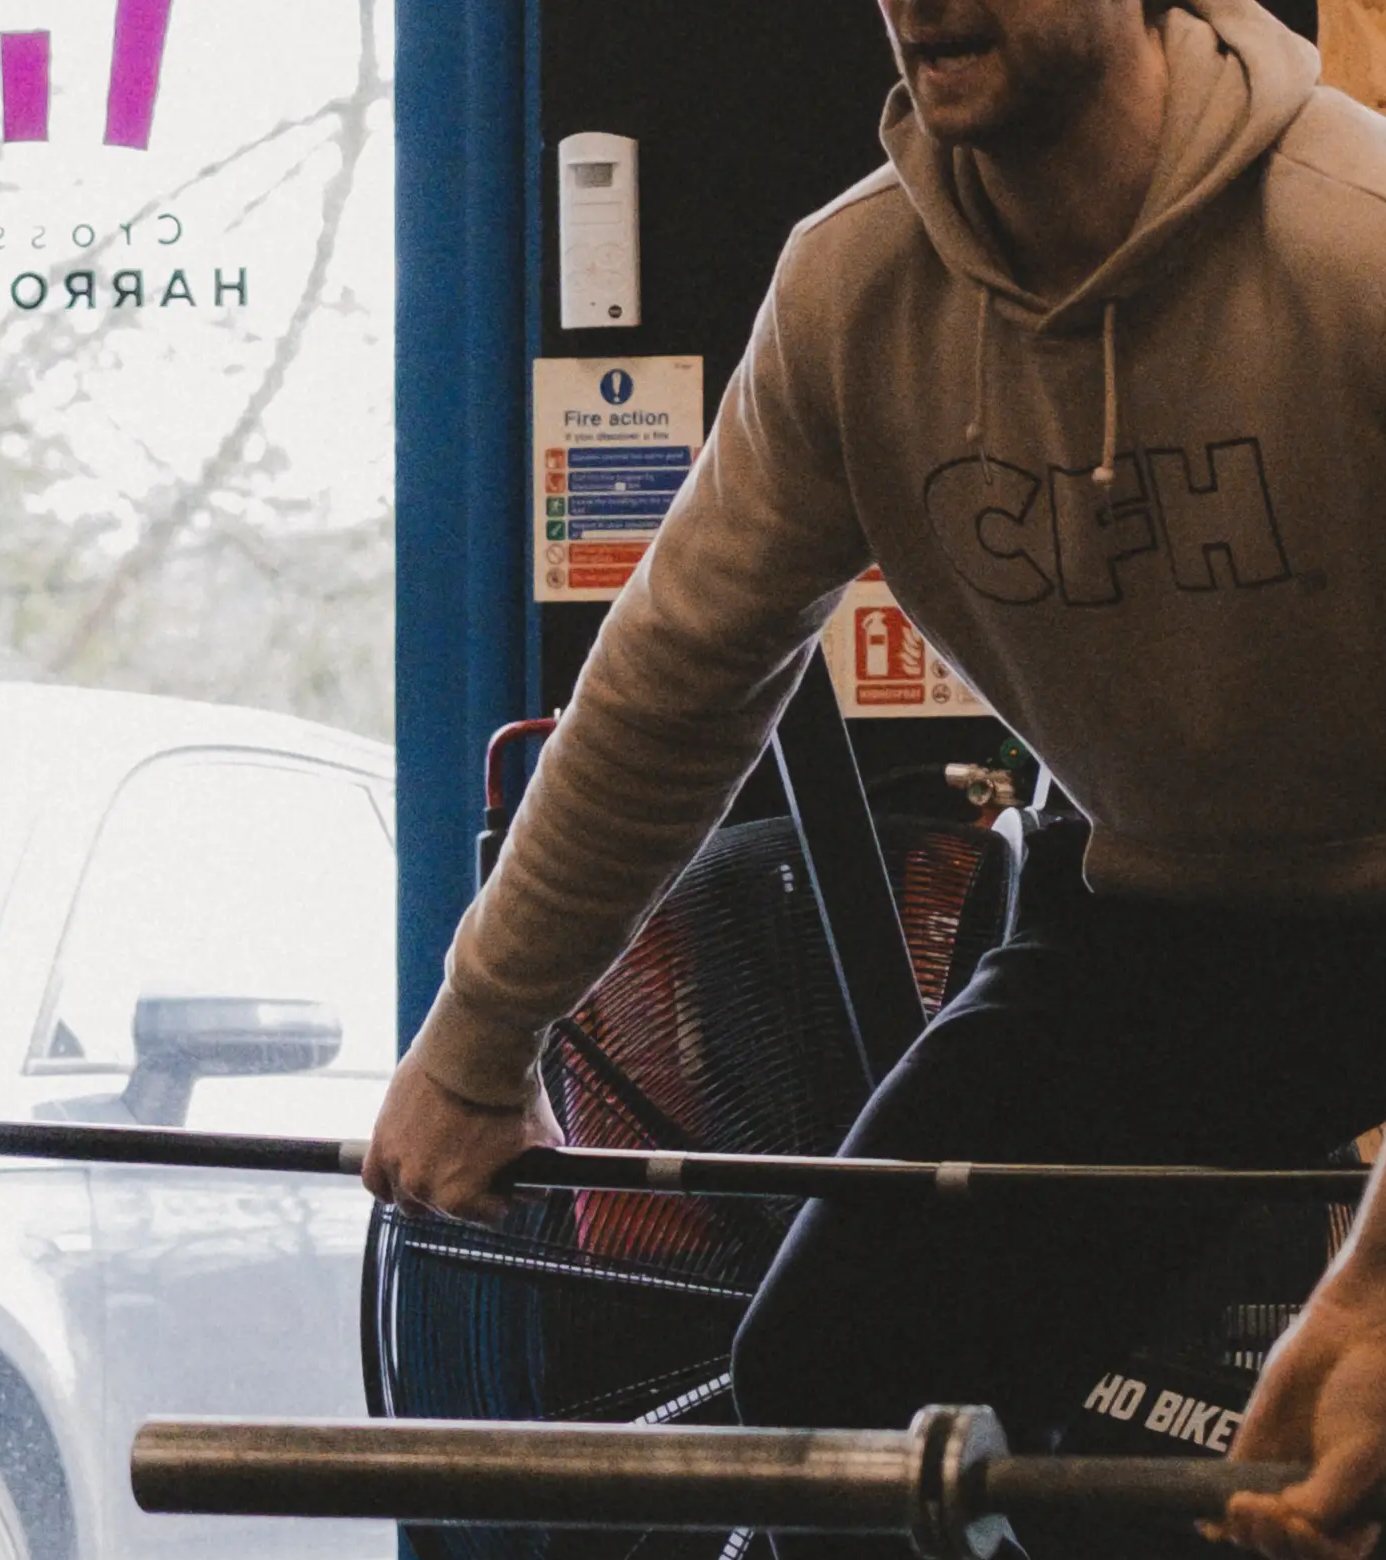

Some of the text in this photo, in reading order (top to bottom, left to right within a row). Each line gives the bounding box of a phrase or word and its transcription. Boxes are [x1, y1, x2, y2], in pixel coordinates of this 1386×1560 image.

[564, 409, 670, 427] Fire action
[924, 436, 1293, 607] CFH
[1144, 1389, 1245, 1454] BIKE
